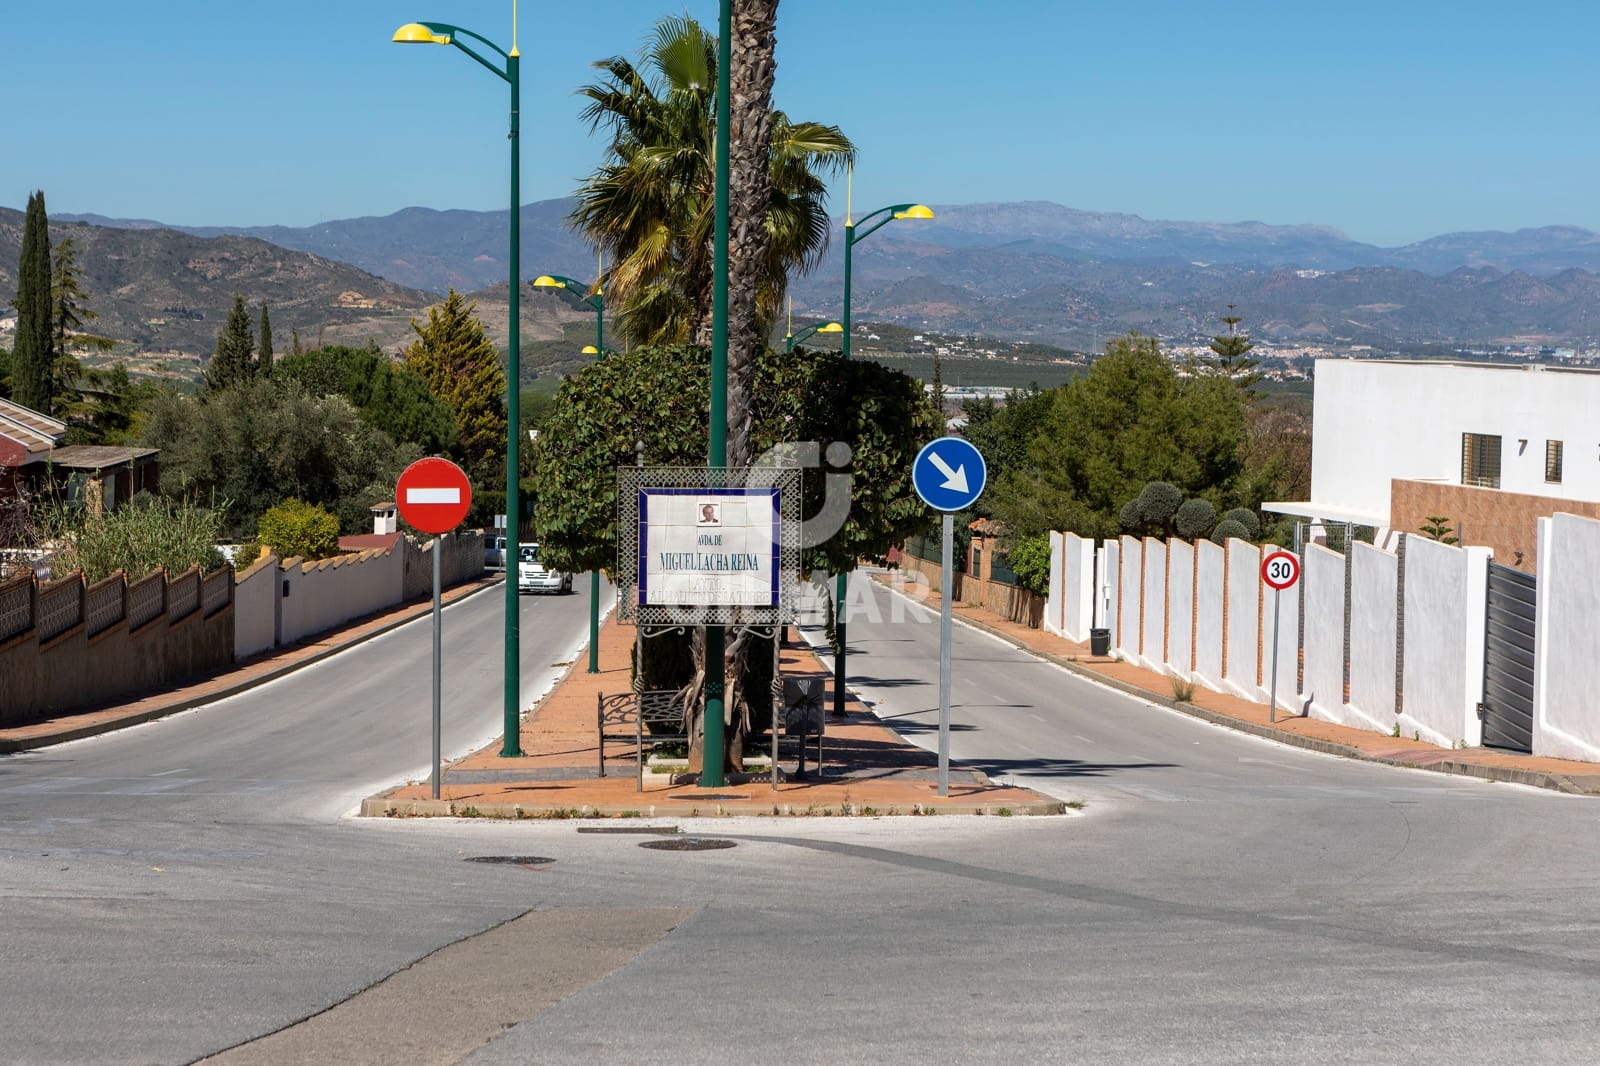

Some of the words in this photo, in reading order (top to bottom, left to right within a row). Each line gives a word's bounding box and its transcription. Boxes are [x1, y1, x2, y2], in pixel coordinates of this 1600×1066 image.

[714, 534, 723, 546] DE
[659, 552, 696, 570] MIGUEL
[697, 552, 729, 571] LACHA
[731, 552, 759, 571] REINA
[1271, 562, 1290, 578] 30
